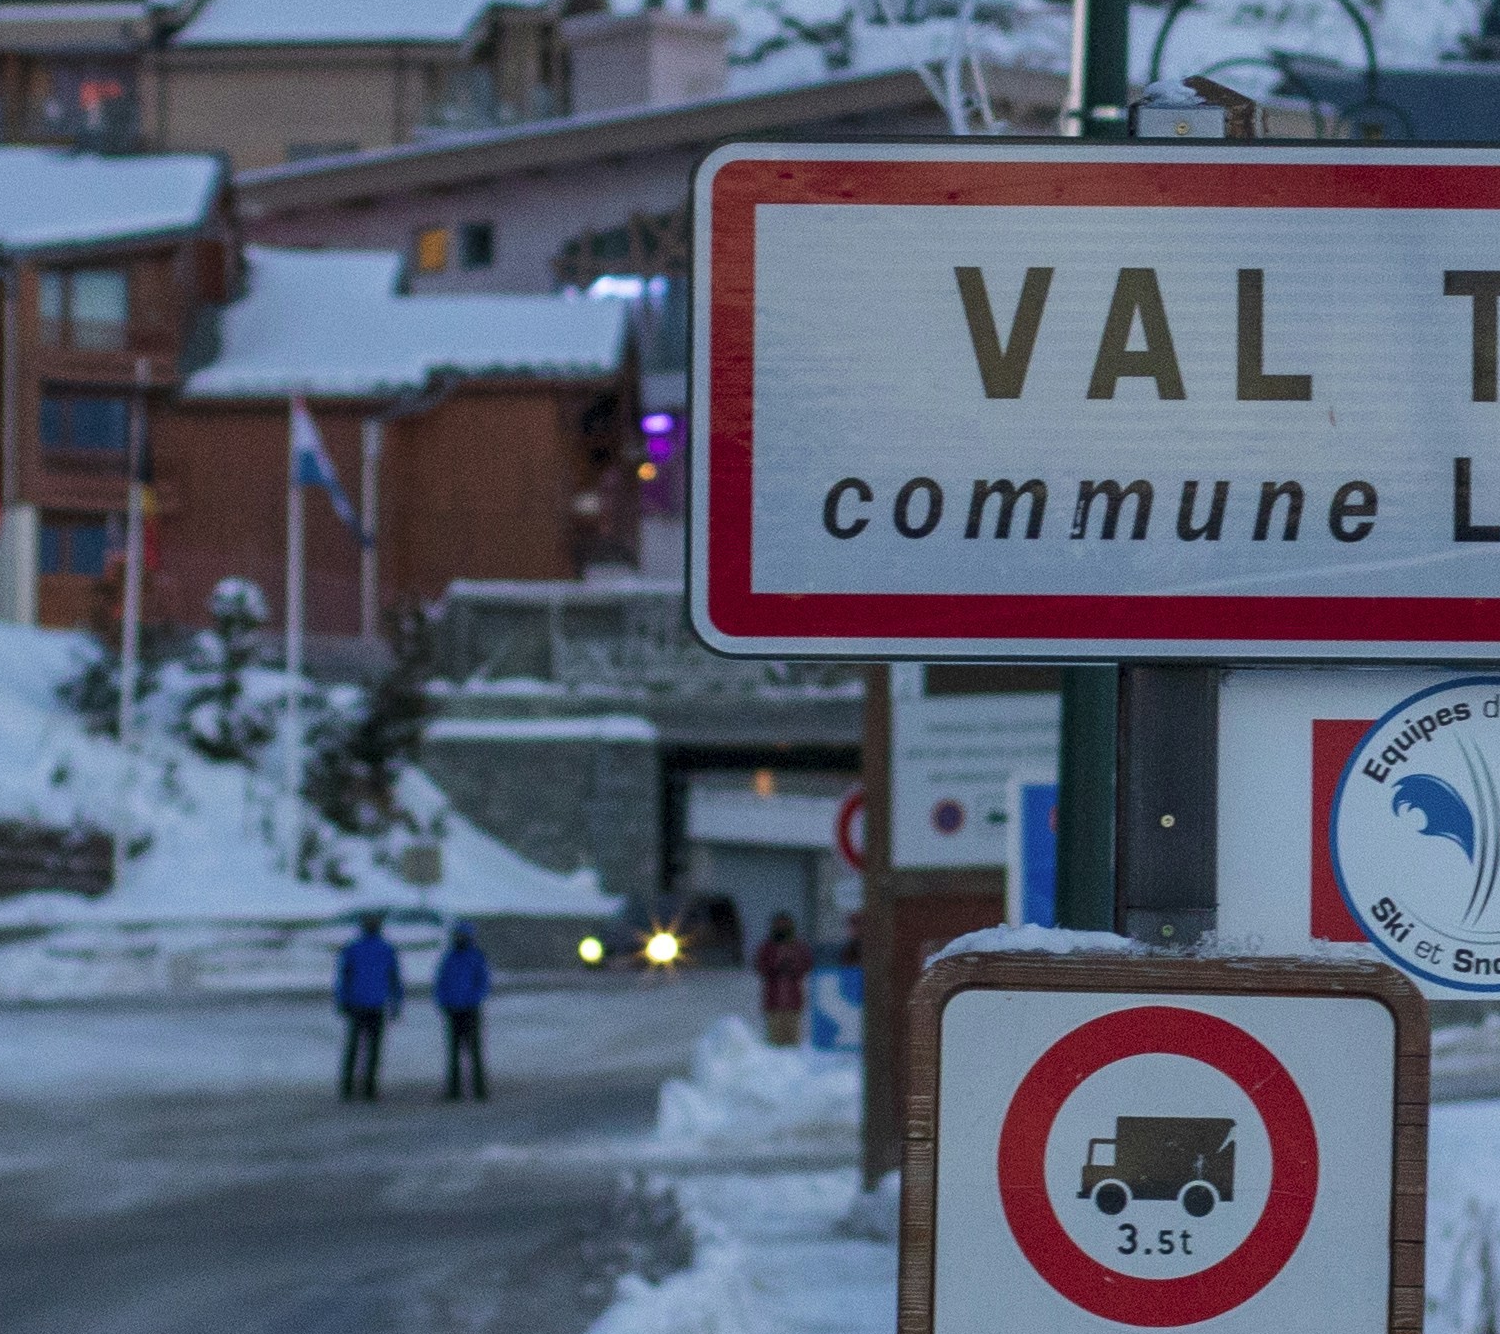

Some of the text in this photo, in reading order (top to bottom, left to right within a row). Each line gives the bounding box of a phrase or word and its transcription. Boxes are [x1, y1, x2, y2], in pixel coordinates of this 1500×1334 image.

[955, 265, 1315, 404] VAL
[822, 476, 1380, 543] commune
[1363, 698, 1471, 784] Equipes
[1372, 897, 1412, 946] Ski
[1415, 936, 1444, 966] et
[1117, 1223, 1193, 1256] 3.5t
